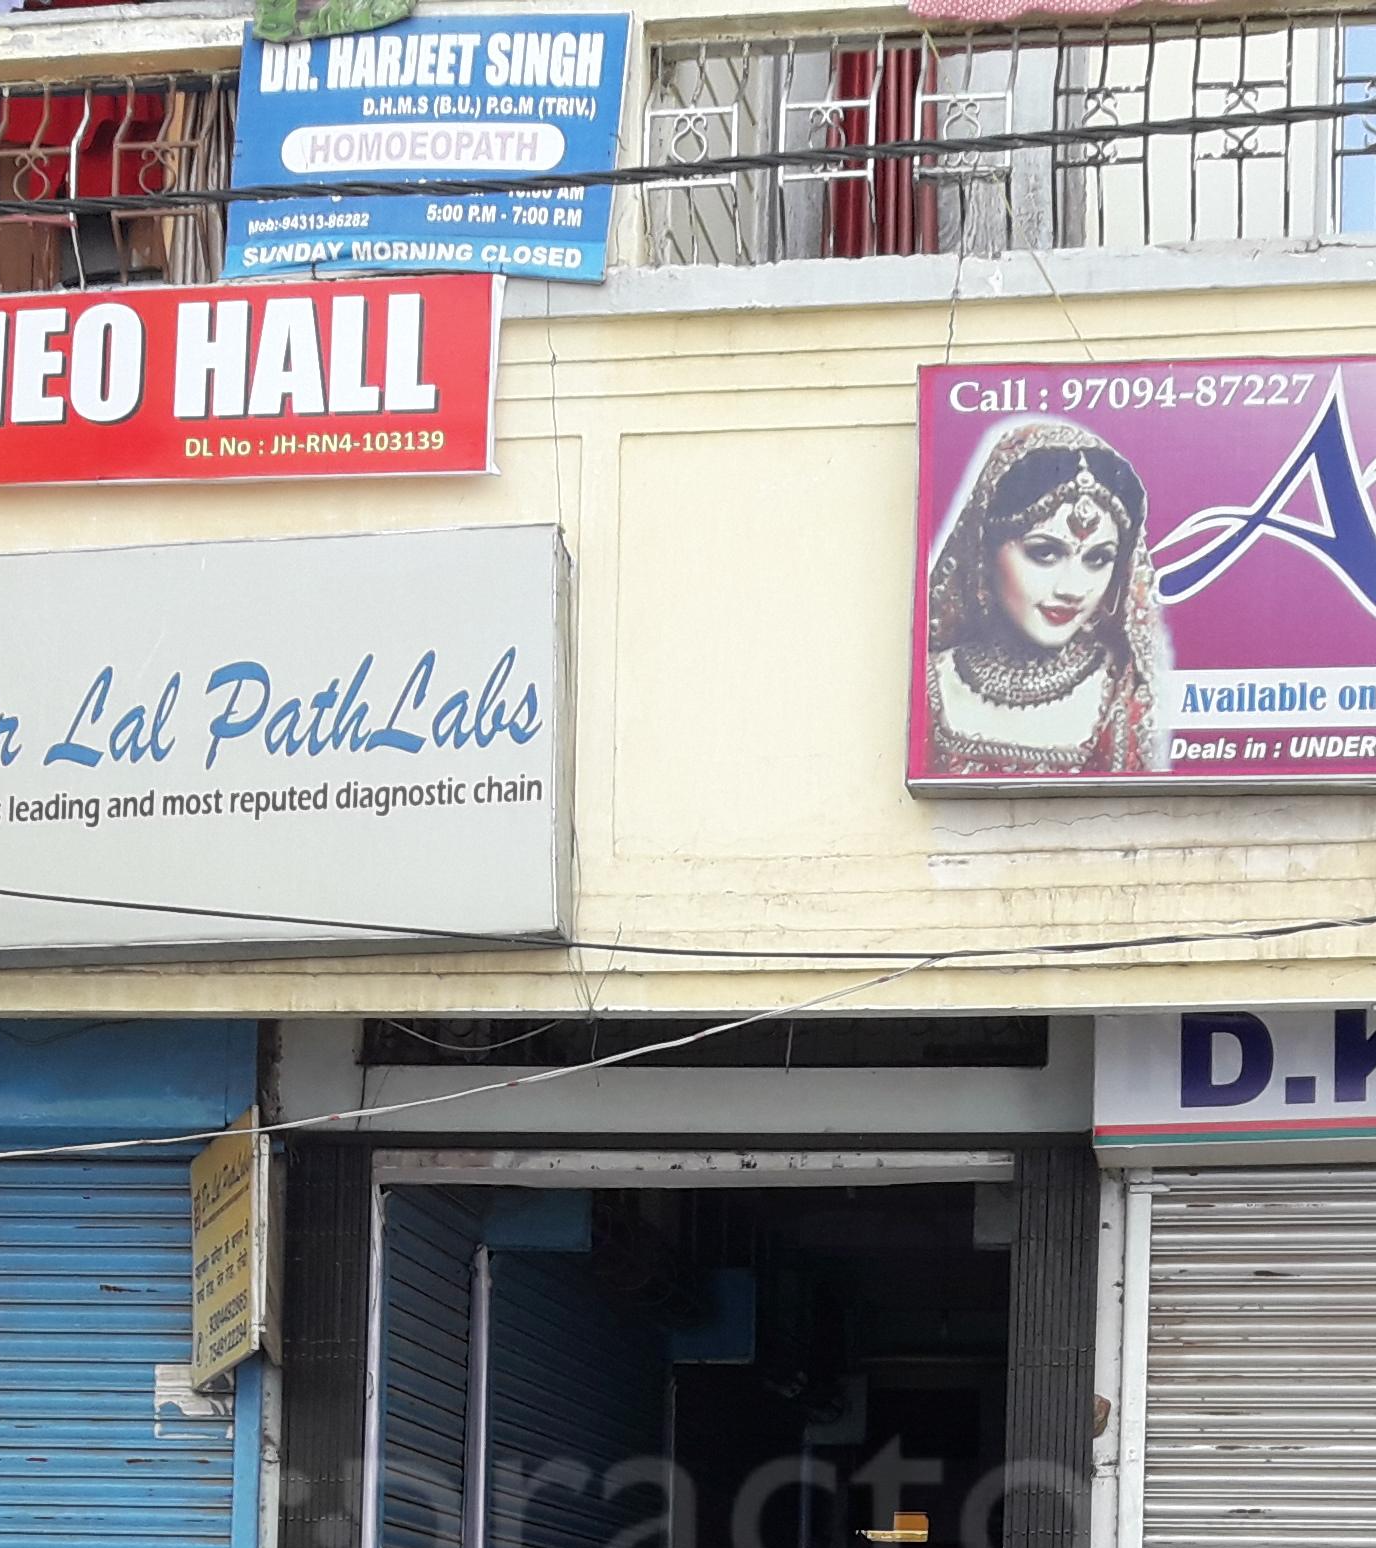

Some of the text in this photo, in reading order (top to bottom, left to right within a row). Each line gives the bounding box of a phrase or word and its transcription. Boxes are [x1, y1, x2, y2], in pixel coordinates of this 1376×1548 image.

[259, 31, 605, 93] DR. HARJEET SINGH
[362, 95, 597, 121] D.H.M.S (B.U.) P.G.M (TRIV.)
[308, 130, 538, 165] HOMOEOPATH
[426, 204, 463, 222] 5:00
[467, 204, 497, 224] P.M
[512, 206, 549, 225] 7:00
[553, 207, 583, 227] P.M
[242, 240, 582, 268] SUNDAY MORNING CLOSED
[173, 293, 440, 420] HALL
[949, 378, 1028, 413] Call
[1062, 373, 1315, 411] 97094-87227
[184, 437, 214, 459] DL
[219, 436, 251, 458] No
[269, 430, 445, 456] JH-RN4-103139
[43, 665, 181, 768] Lal
[205, 645, 544, 771] PathLabs
[1181, 680, 1326, 714] Available
[1338, 686, 1373, 712] on
[1171, 738, 1236, 760] Deals
[1243, 737, 1267, 759] in
[9, 792, 101, 828] leading
[107, 790, 155, 818] and
[162, 790, 223, 817] most
[230, 783, 328, 821] reputed
[335, 777, 466, 817] diagnostic
[473, 773, 543, 804] chain
